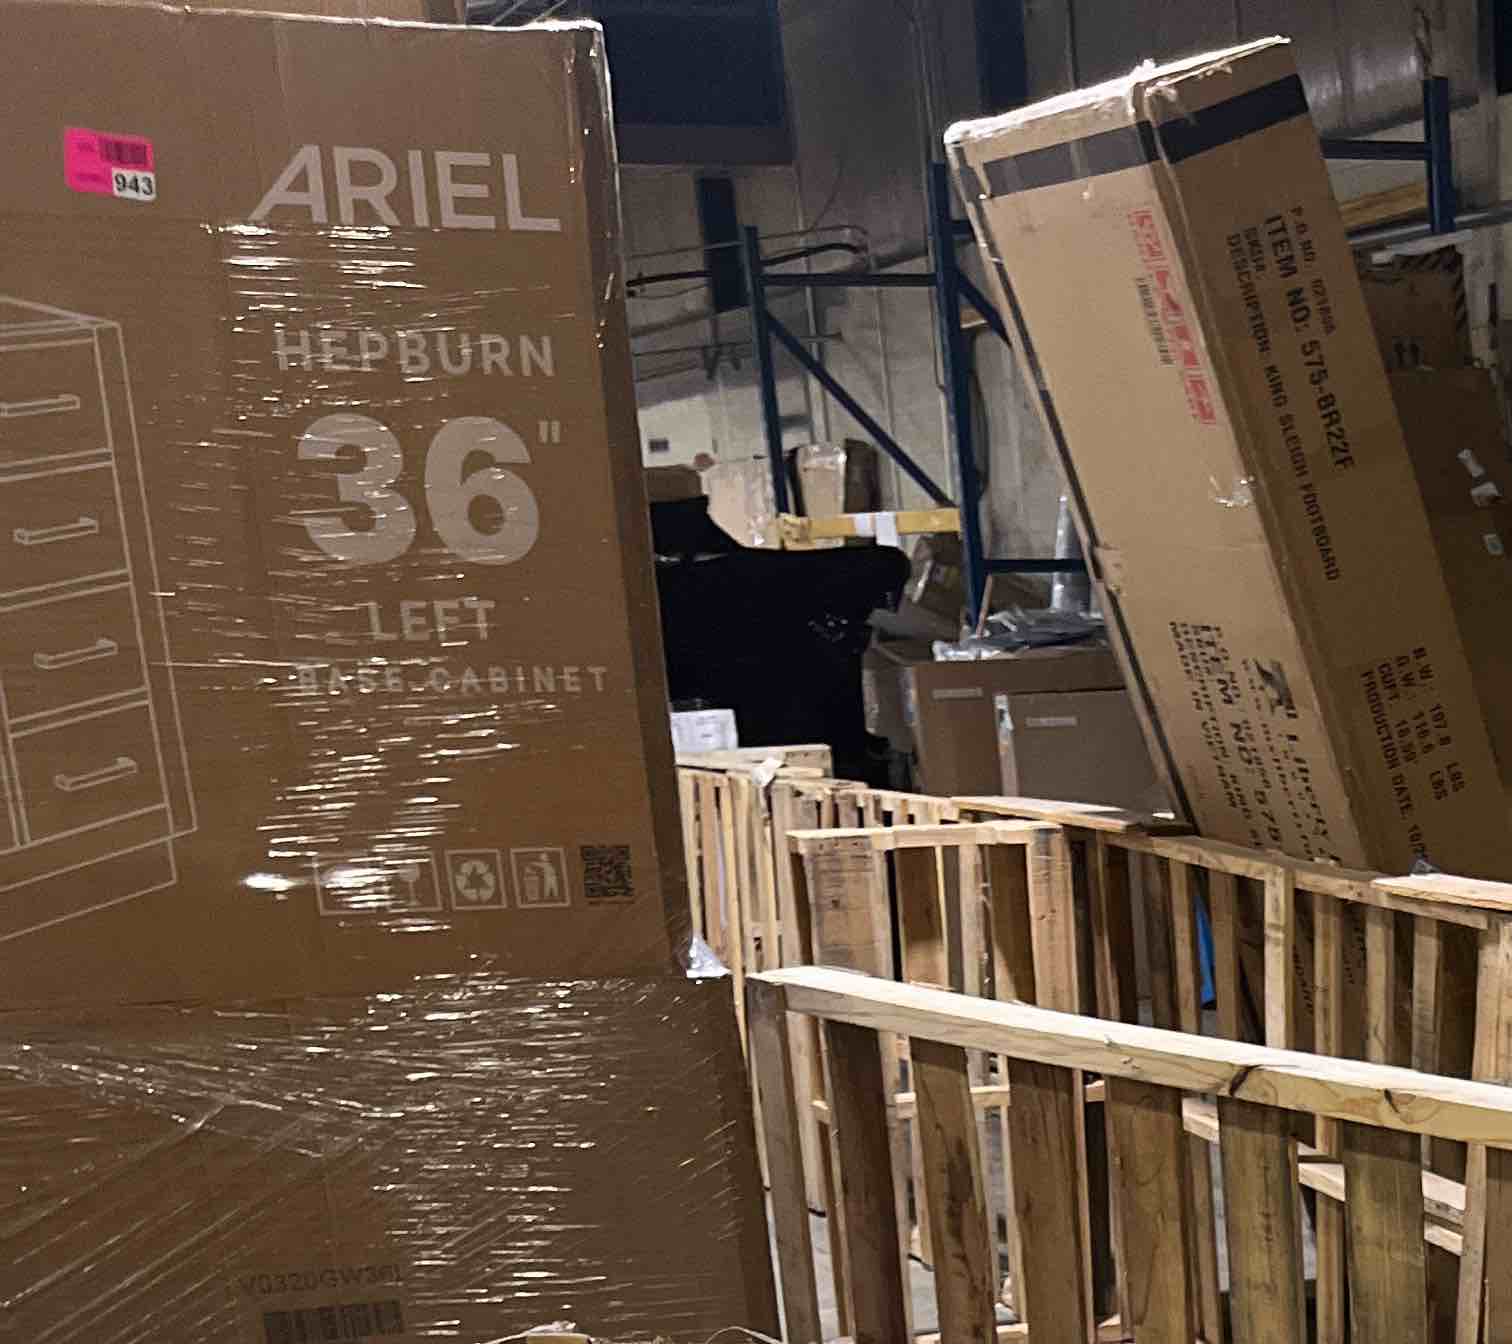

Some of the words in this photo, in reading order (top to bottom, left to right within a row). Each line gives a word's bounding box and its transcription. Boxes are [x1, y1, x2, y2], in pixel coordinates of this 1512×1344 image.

[115, 173, 153, 195] 943
[247, 144, 562, 232] ARIEL
[1265, 215, 1298, 279] ITEM
[274, 330, 555, 377] HEPBURN
[367, 600, 496, 641] LEFT
[429, 665, 608, 694] CABINET
